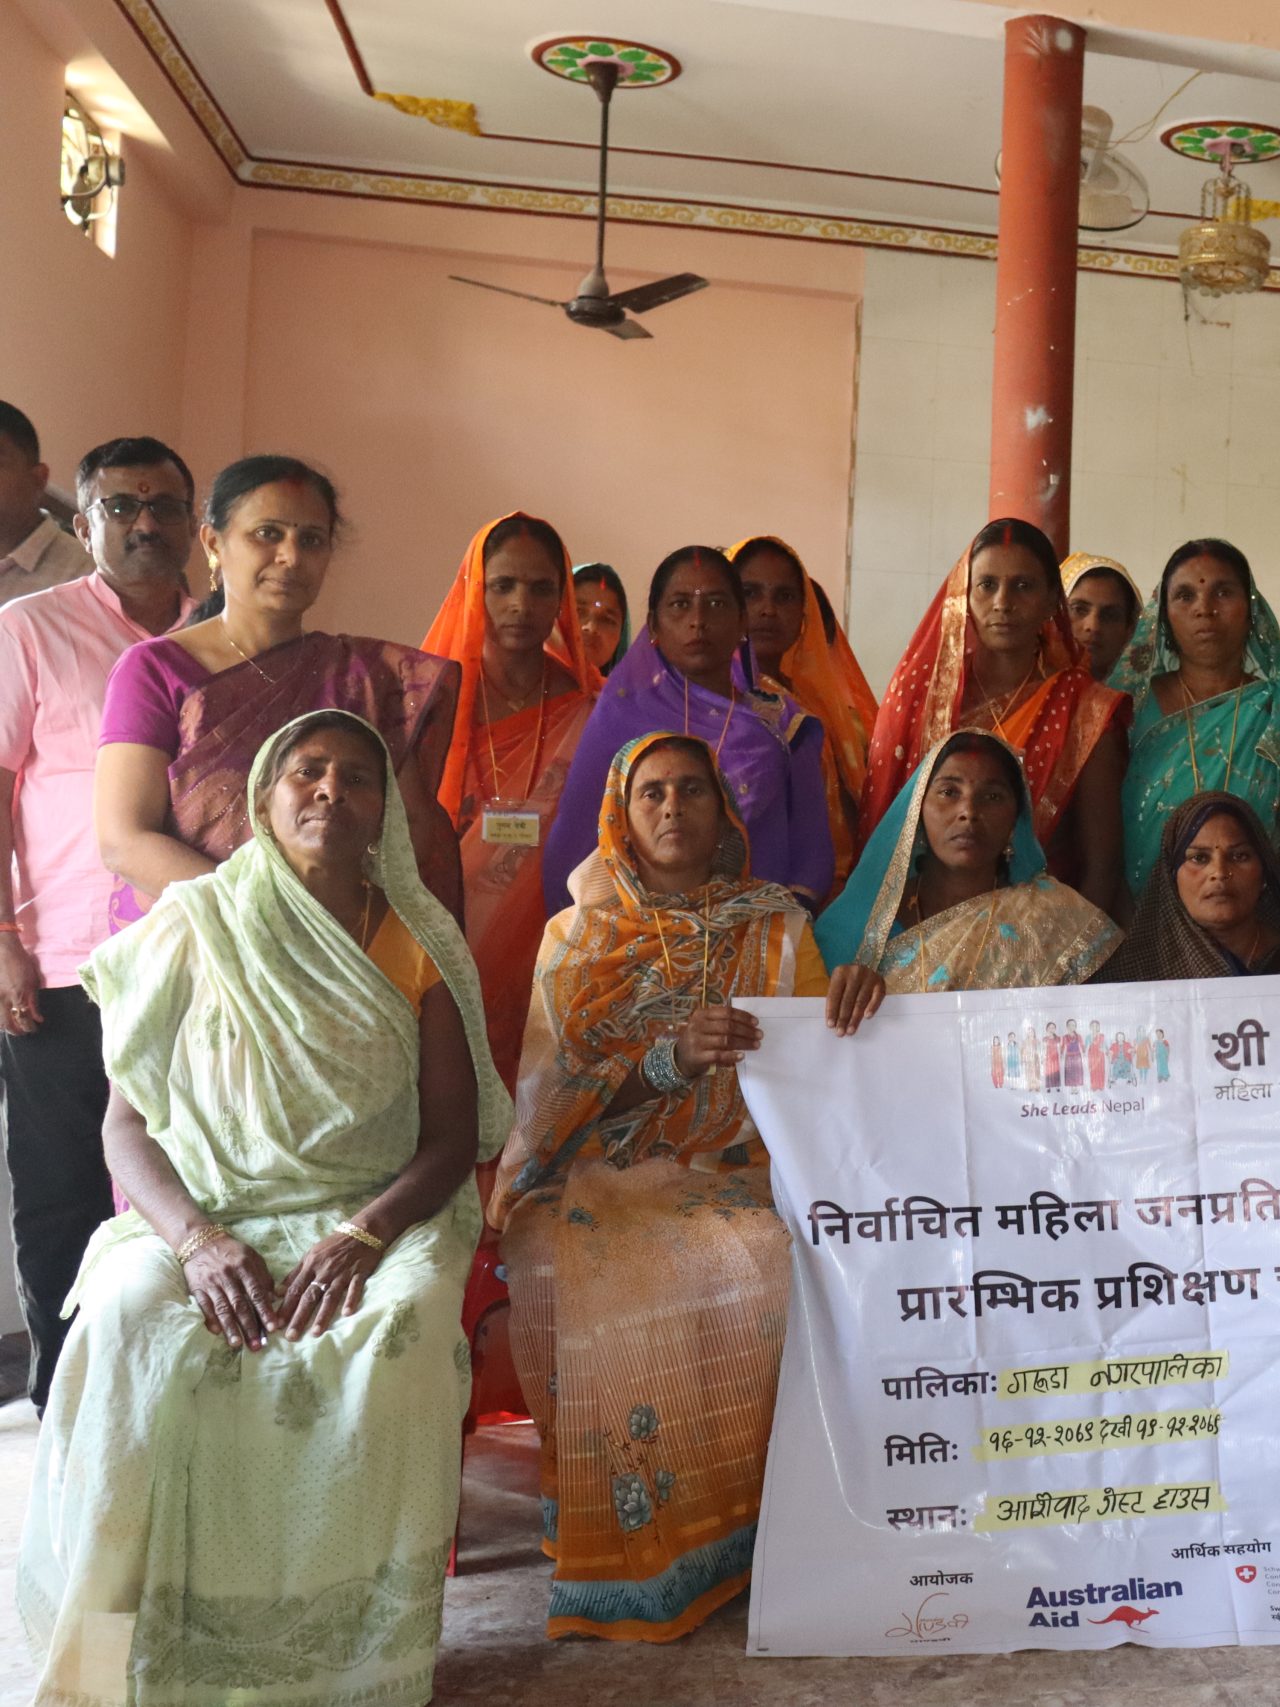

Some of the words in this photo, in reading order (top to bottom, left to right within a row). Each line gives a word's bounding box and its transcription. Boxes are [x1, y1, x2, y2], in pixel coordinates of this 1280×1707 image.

[1211, 1018, 1270, 1071] शी
[1214, 1078, 1273, 1101] महिला
[1021, 1104, 1048, 1117] She
[1053, 1101, 1097, 1115] Leads
[1102, 1097, 1145, 1115] Nepal
[808, 1195, 982, 1245] निर्वाचित
[995, 1190, 1120, 1241] महिला
[898, 1269, 1081, 1321] प्रारम्भिक
[1094, 1261, 1260, 1311] प्रशिक्षण
[1171, 1542, 1220, 1559] आर्थिक
[1223, 1538, 1271, 1555] सहयोग
[909, 1570, 974, 1587] आयोजक
[1026, 1577, 1183, 1609] Australian
[1028, 1610, 1080, 1628] Aid
